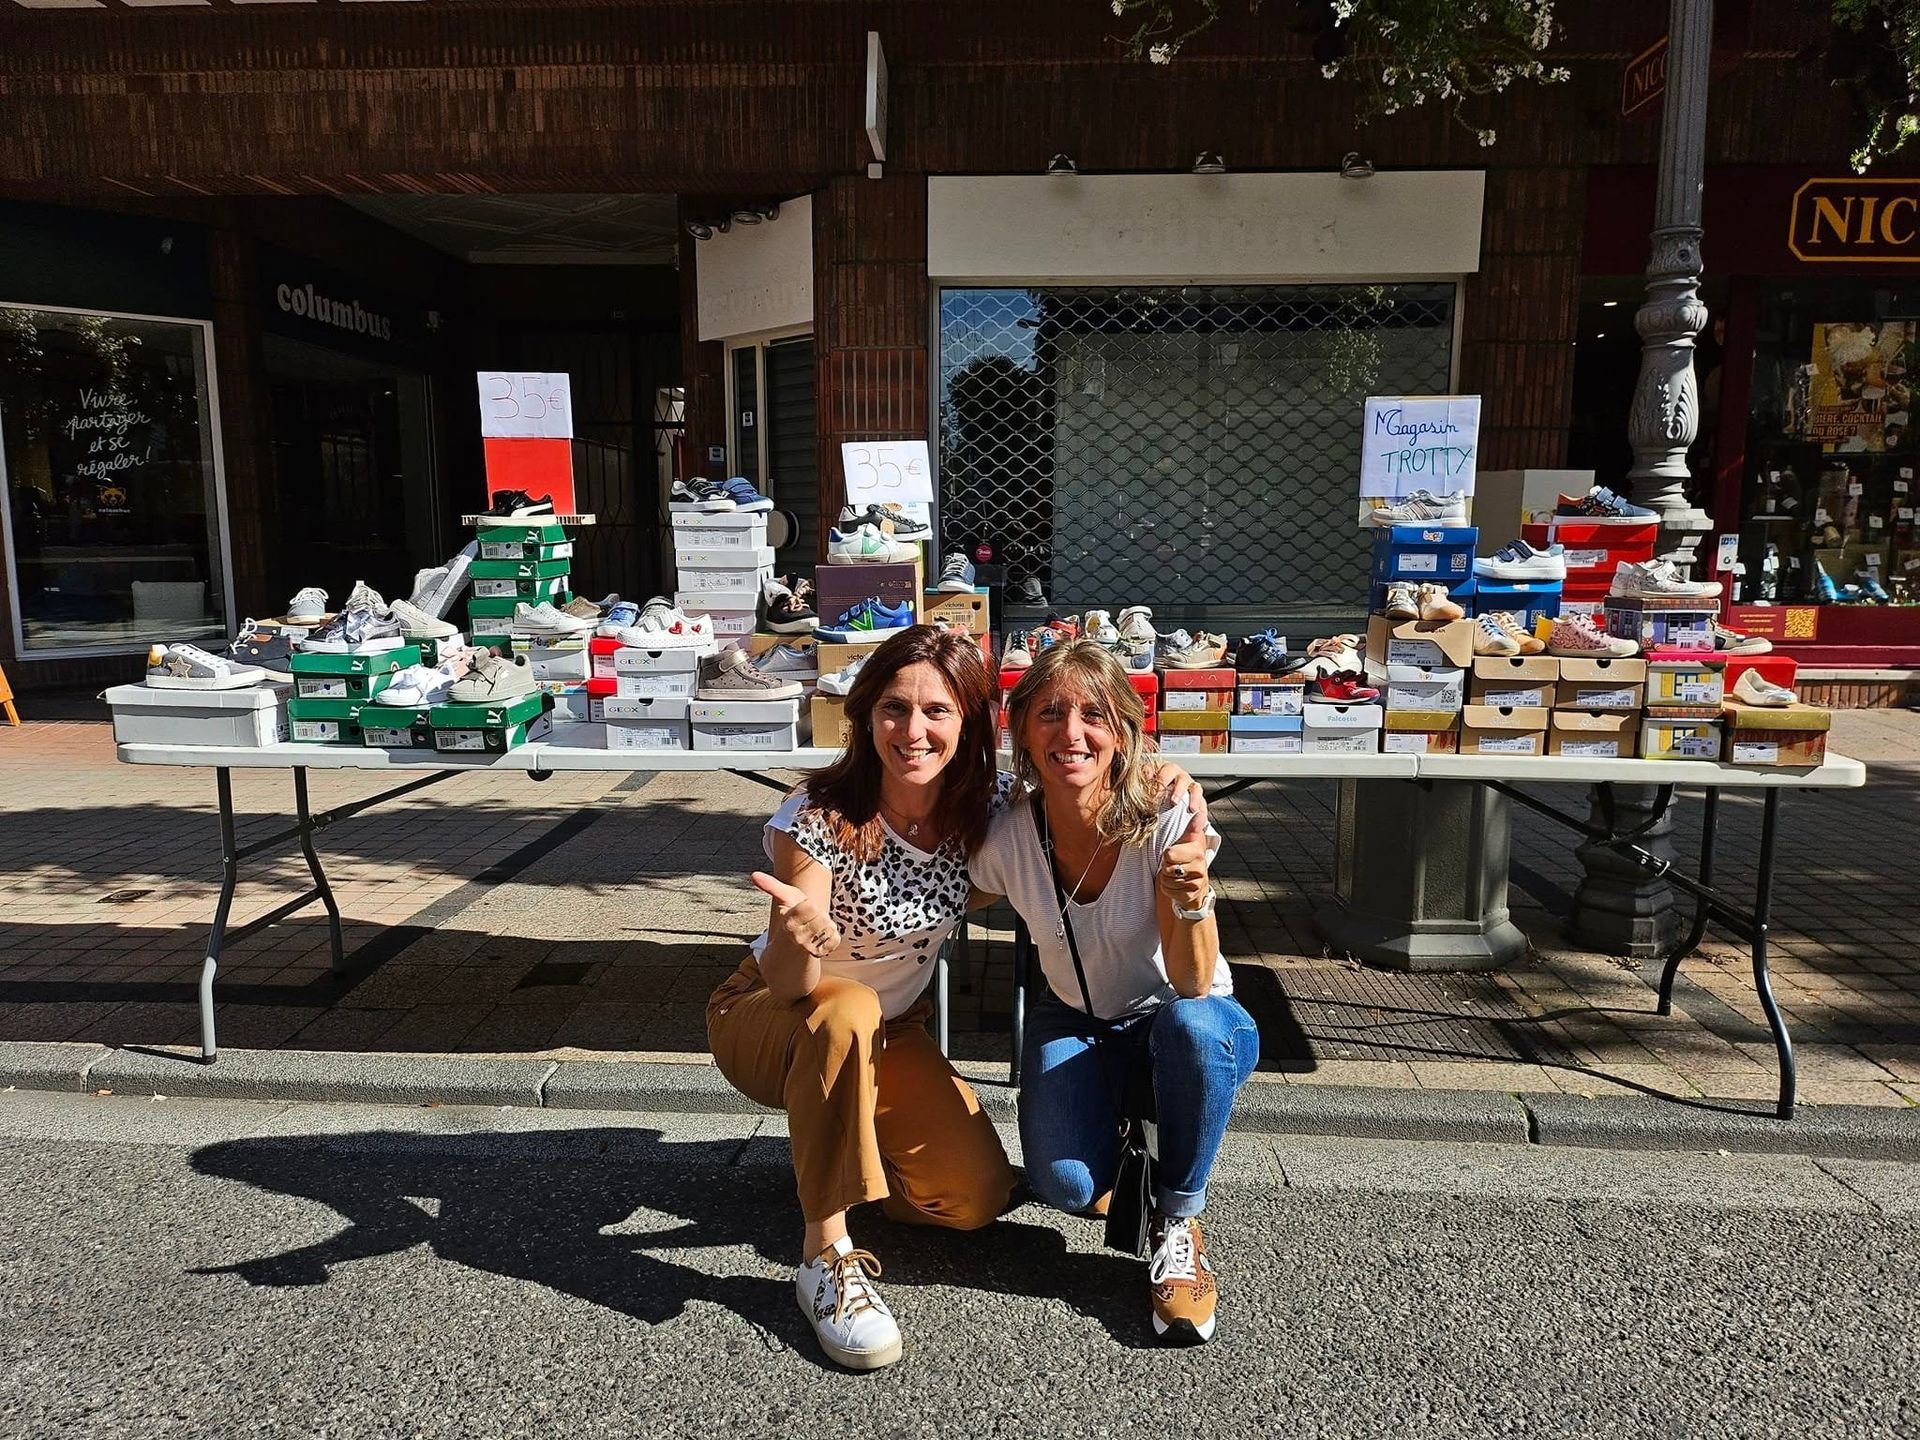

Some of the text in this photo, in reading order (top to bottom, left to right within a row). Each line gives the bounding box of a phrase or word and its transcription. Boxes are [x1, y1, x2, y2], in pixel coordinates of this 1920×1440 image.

[1807, 195, 1918, 246] NIC
[276, 283, 391, 341] columbus
[65, 411, 152, 440] partager
[1374, 408, 1460, 447] Magasin
[88, 436, 130, 454] et se
[1380, 446, 1473, 476] TROTTY
[619, 658, 651, 666] GEOX
